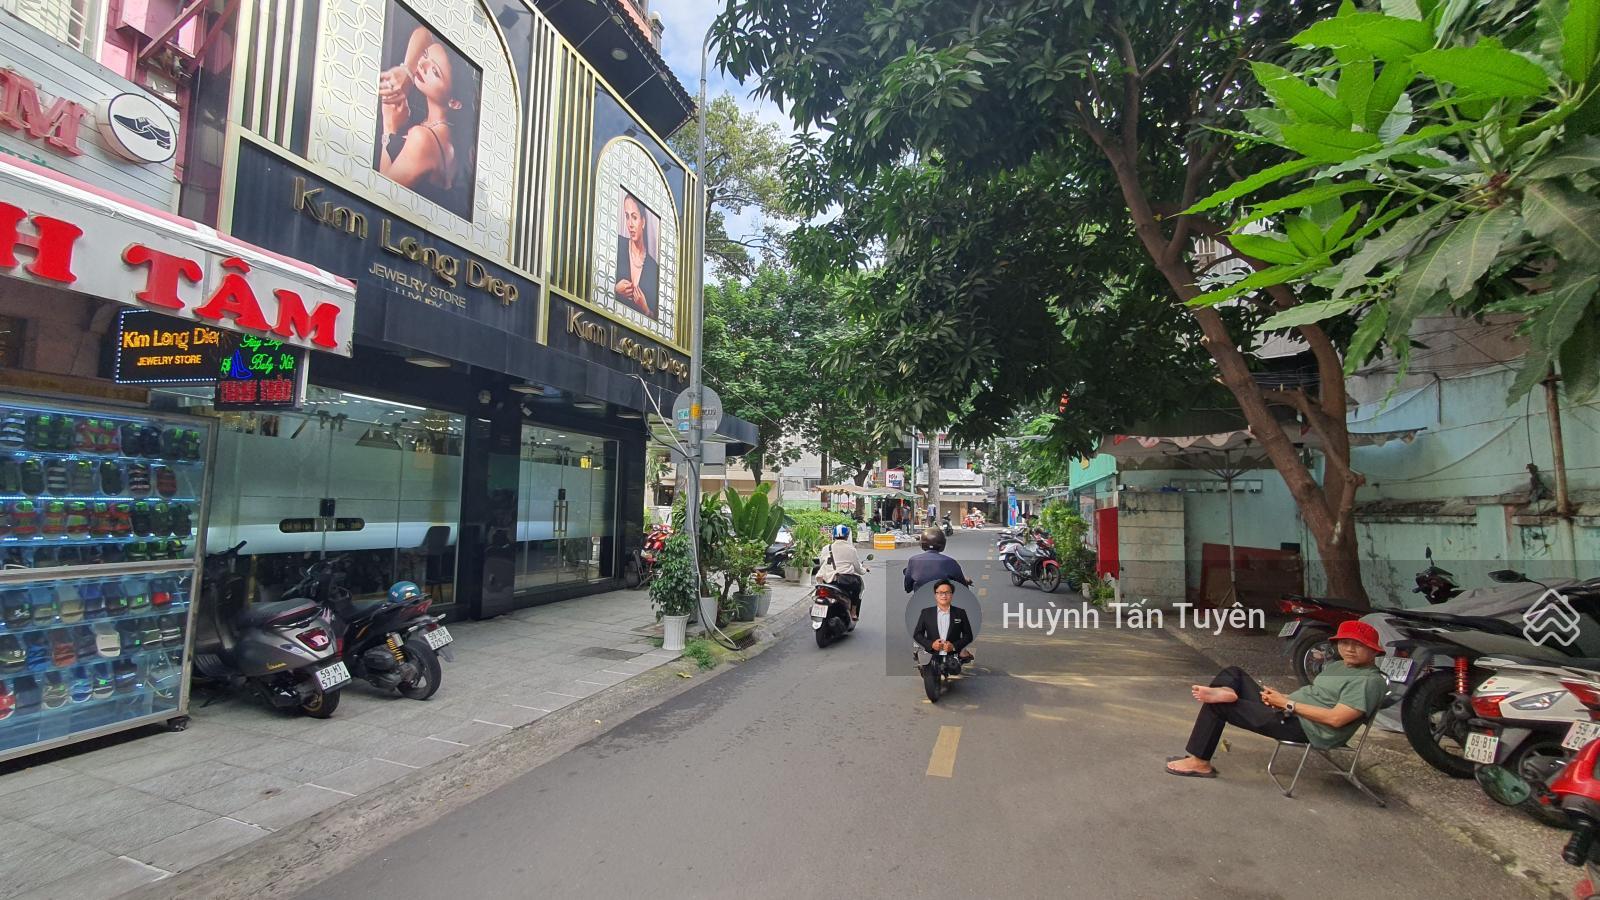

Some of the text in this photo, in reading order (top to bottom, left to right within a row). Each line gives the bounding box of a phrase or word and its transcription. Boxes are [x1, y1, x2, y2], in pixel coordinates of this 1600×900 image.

[293, 176, 519, 306] Kim Long Diep
[122, 242, 341, 348] TÂM
[369, 262, 427, 293] JEWELRY
[429, 286, 466, 308] STORE
[123, 331, 150, 348] Kim
[153, 329, 190, 351] Long
[137, 354, 202, 366] JEWELRY STORE
[567, 305, 688, 383] Kim Long Diep
[320, 663, 342, 679] 59-H1
